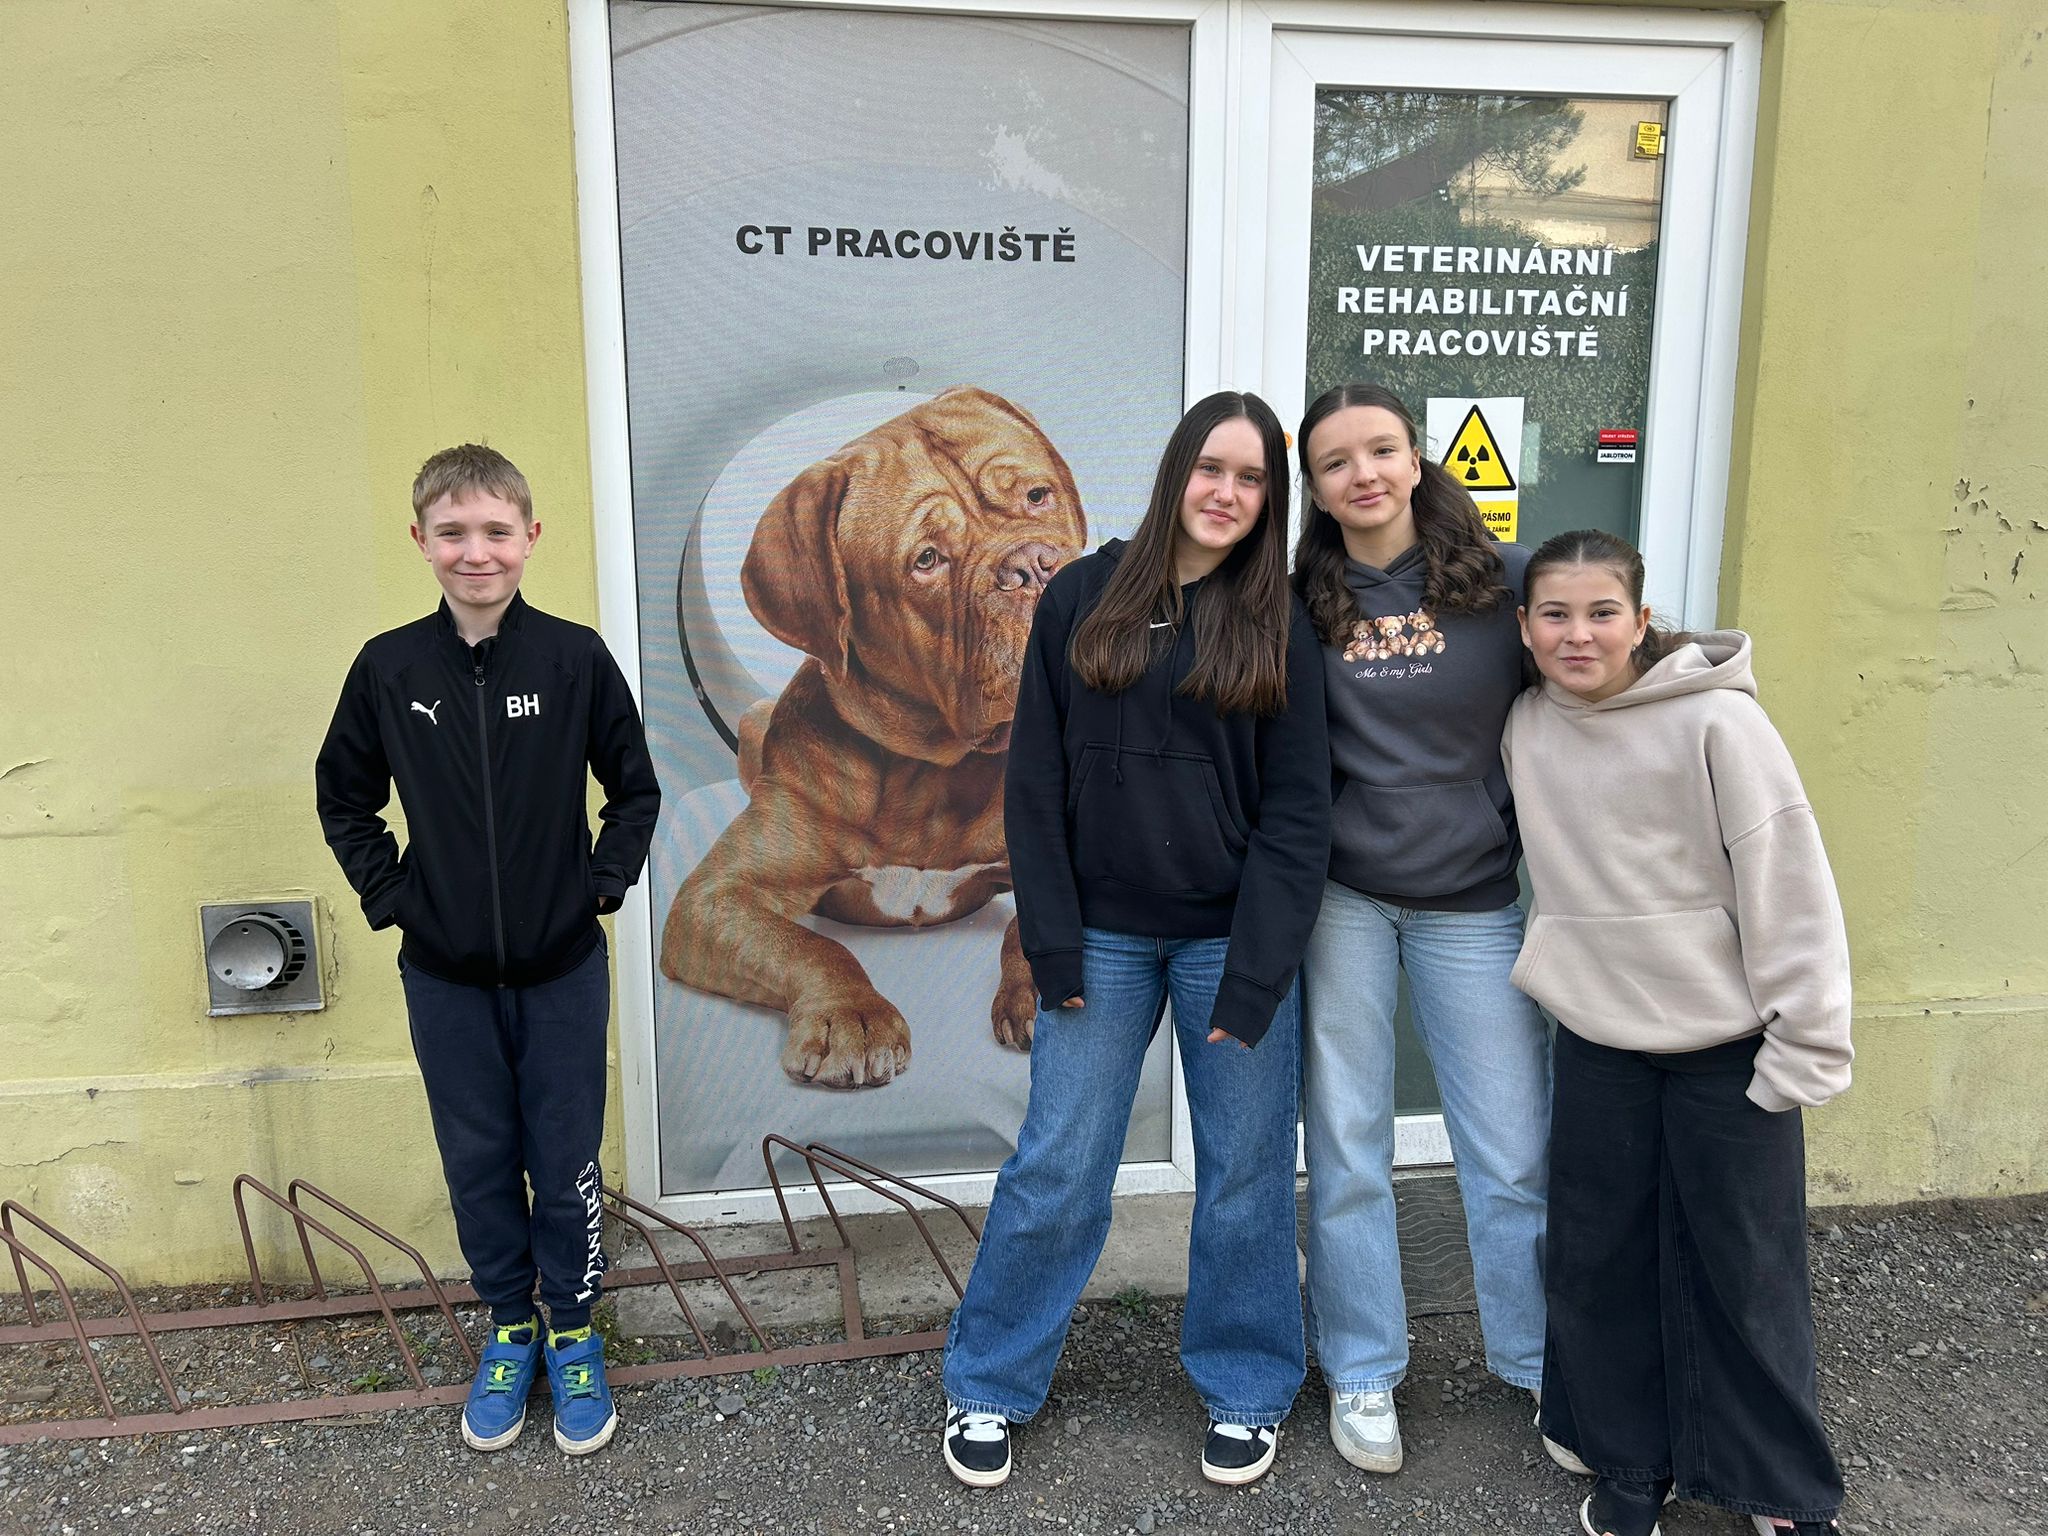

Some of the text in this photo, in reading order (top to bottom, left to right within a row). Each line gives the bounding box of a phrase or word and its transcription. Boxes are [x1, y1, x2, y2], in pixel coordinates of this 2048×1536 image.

[735, 224, 1076, 263] CT PRACOVIŠTĚ
[1356, 242, 1614, 275] VETERINÁRNÍ
[1337, 284, 1629, 317] REHABILITAČNÍ
[1362, 325, 1599, 357] PRACOVIŠTĚ
[1481, 510, 1511, 522] PÁSMO
[1389, 668, 1406, 679] my
[506, 694, 540, 718] BH
